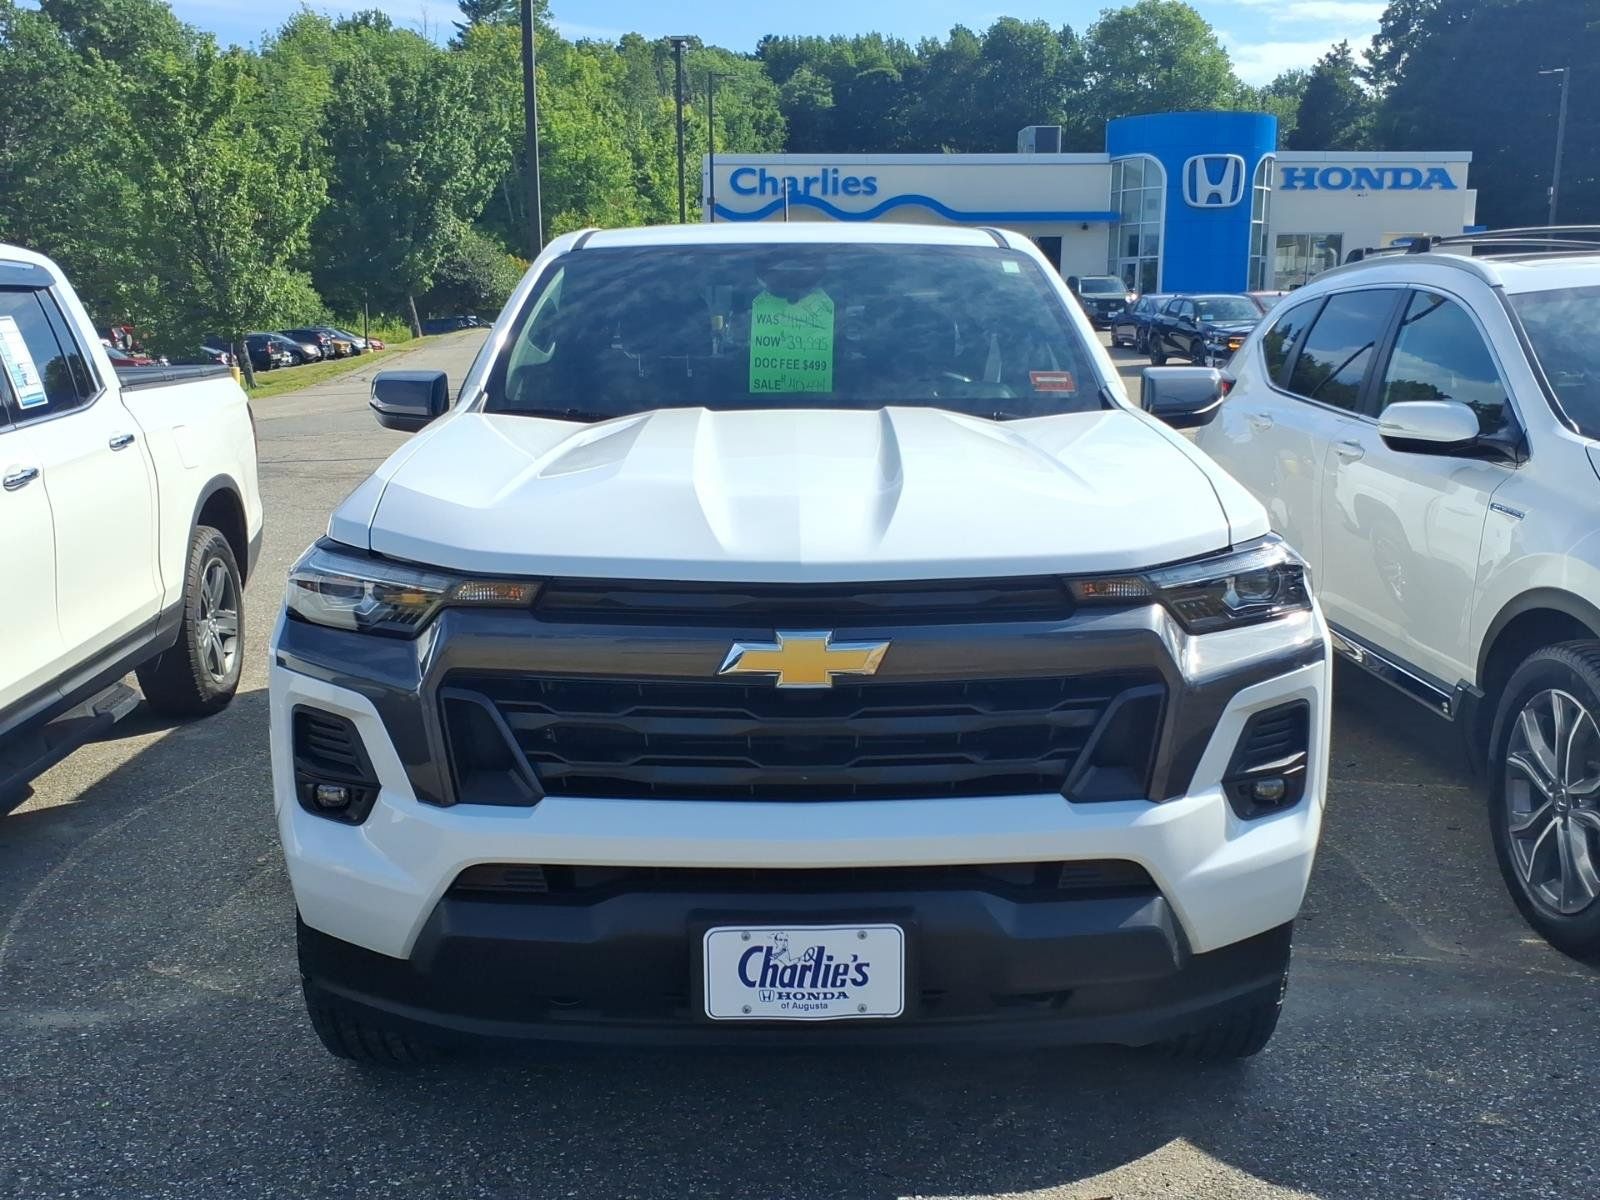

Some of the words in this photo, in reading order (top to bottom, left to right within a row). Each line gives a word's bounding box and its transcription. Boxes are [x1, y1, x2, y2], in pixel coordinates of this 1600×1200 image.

[729, 167, 878, 197] Charlies
[1279, 166, 1458, 190] HONDA
[756, 313, 779, 325] WAS
[755, 336, 780, 347] NOW
[754, 357, 778, 369] DOC
[779, 358, 800, 370] FEE
[802, 360, 827, 371] $499
[753, 379, 781, 391] SALE
[738, 945, 870, 988] Charlie's
[776, 991, 850, 1001] HONDA
[781, 1001, 791, 1010] of
[792, 1001, 828, 1011] Augusta
